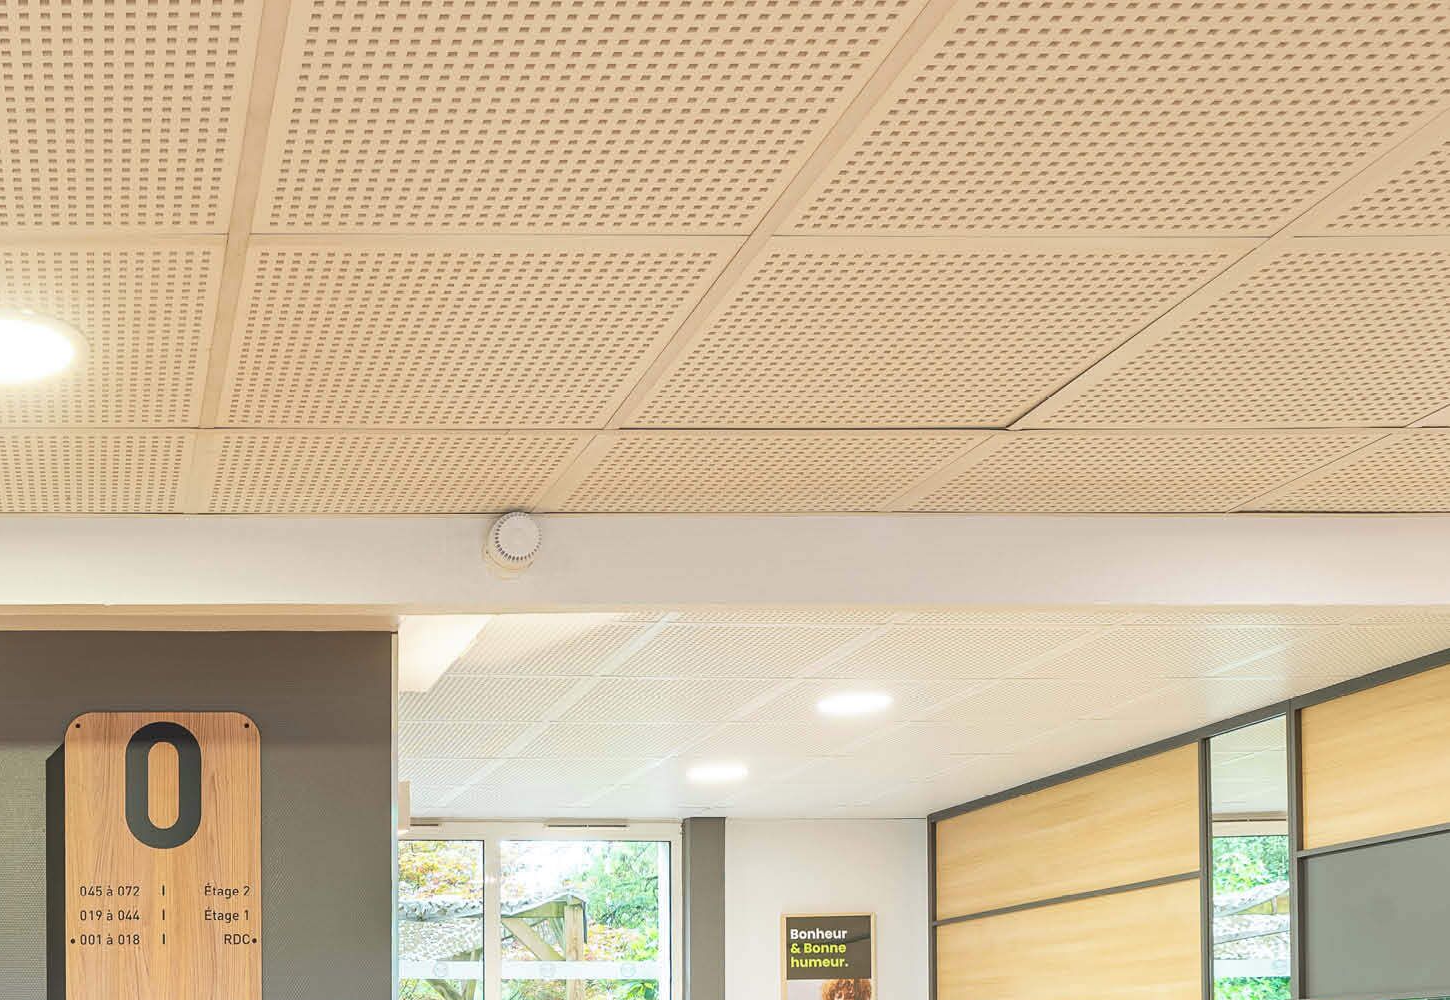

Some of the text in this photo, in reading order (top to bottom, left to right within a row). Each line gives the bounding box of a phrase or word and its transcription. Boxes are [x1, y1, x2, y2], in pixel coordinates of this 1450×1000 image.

[79, 882, 250, 899] 045 à 072 Étage 2
[79, 907, 249, 923] 019 à 044 Étage 1
[79, 932, 250, 945] 001 à 018 RDC
[790, 928, 848, 940] Bonheur
[790, 943, 847, 954] & Bonne
[790, 956, 849, 968] humeur.
